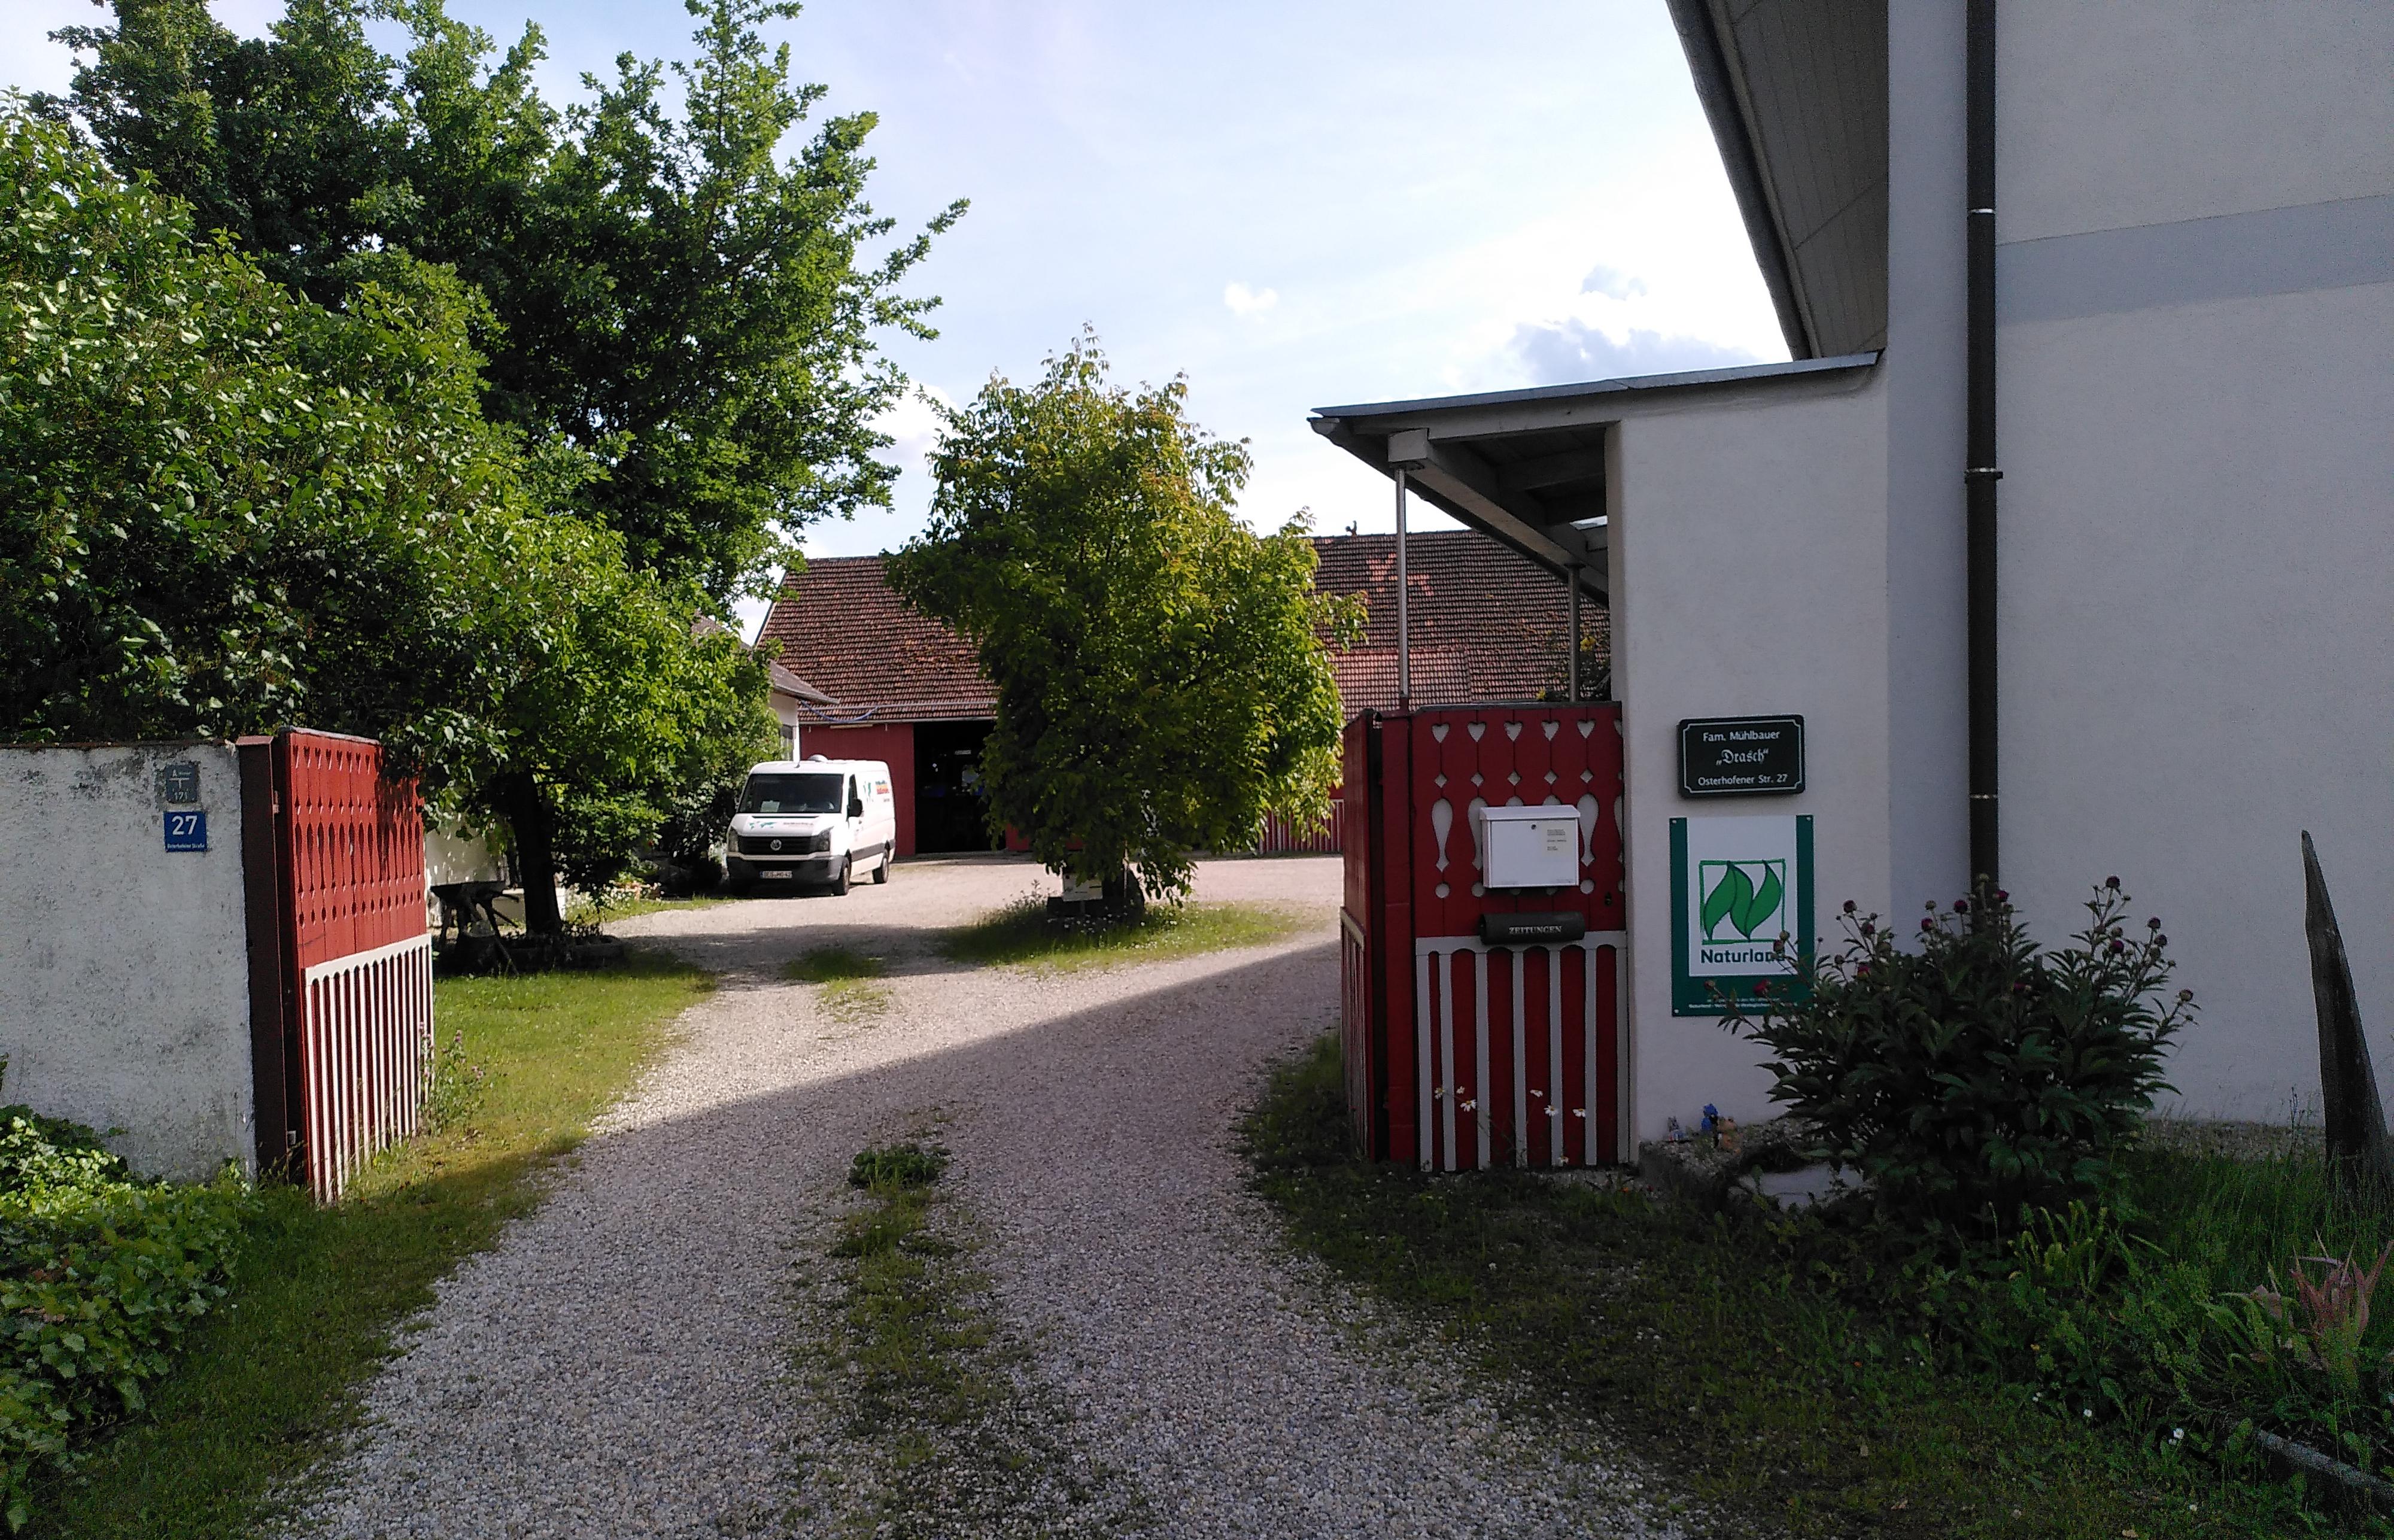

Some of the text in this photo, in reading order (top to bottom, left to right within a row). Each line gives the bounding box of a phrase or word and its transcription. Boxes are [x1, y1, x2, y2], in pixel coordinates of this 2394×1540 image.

[1703, 730, 1781, 742] Fam. Mühlbauer
[1698, 773, 1788, 786] Osterhofener Str. 27
[171, 815, 198, 836] 27
[1509, 925, 1562, 934] ZEITUNGEN
